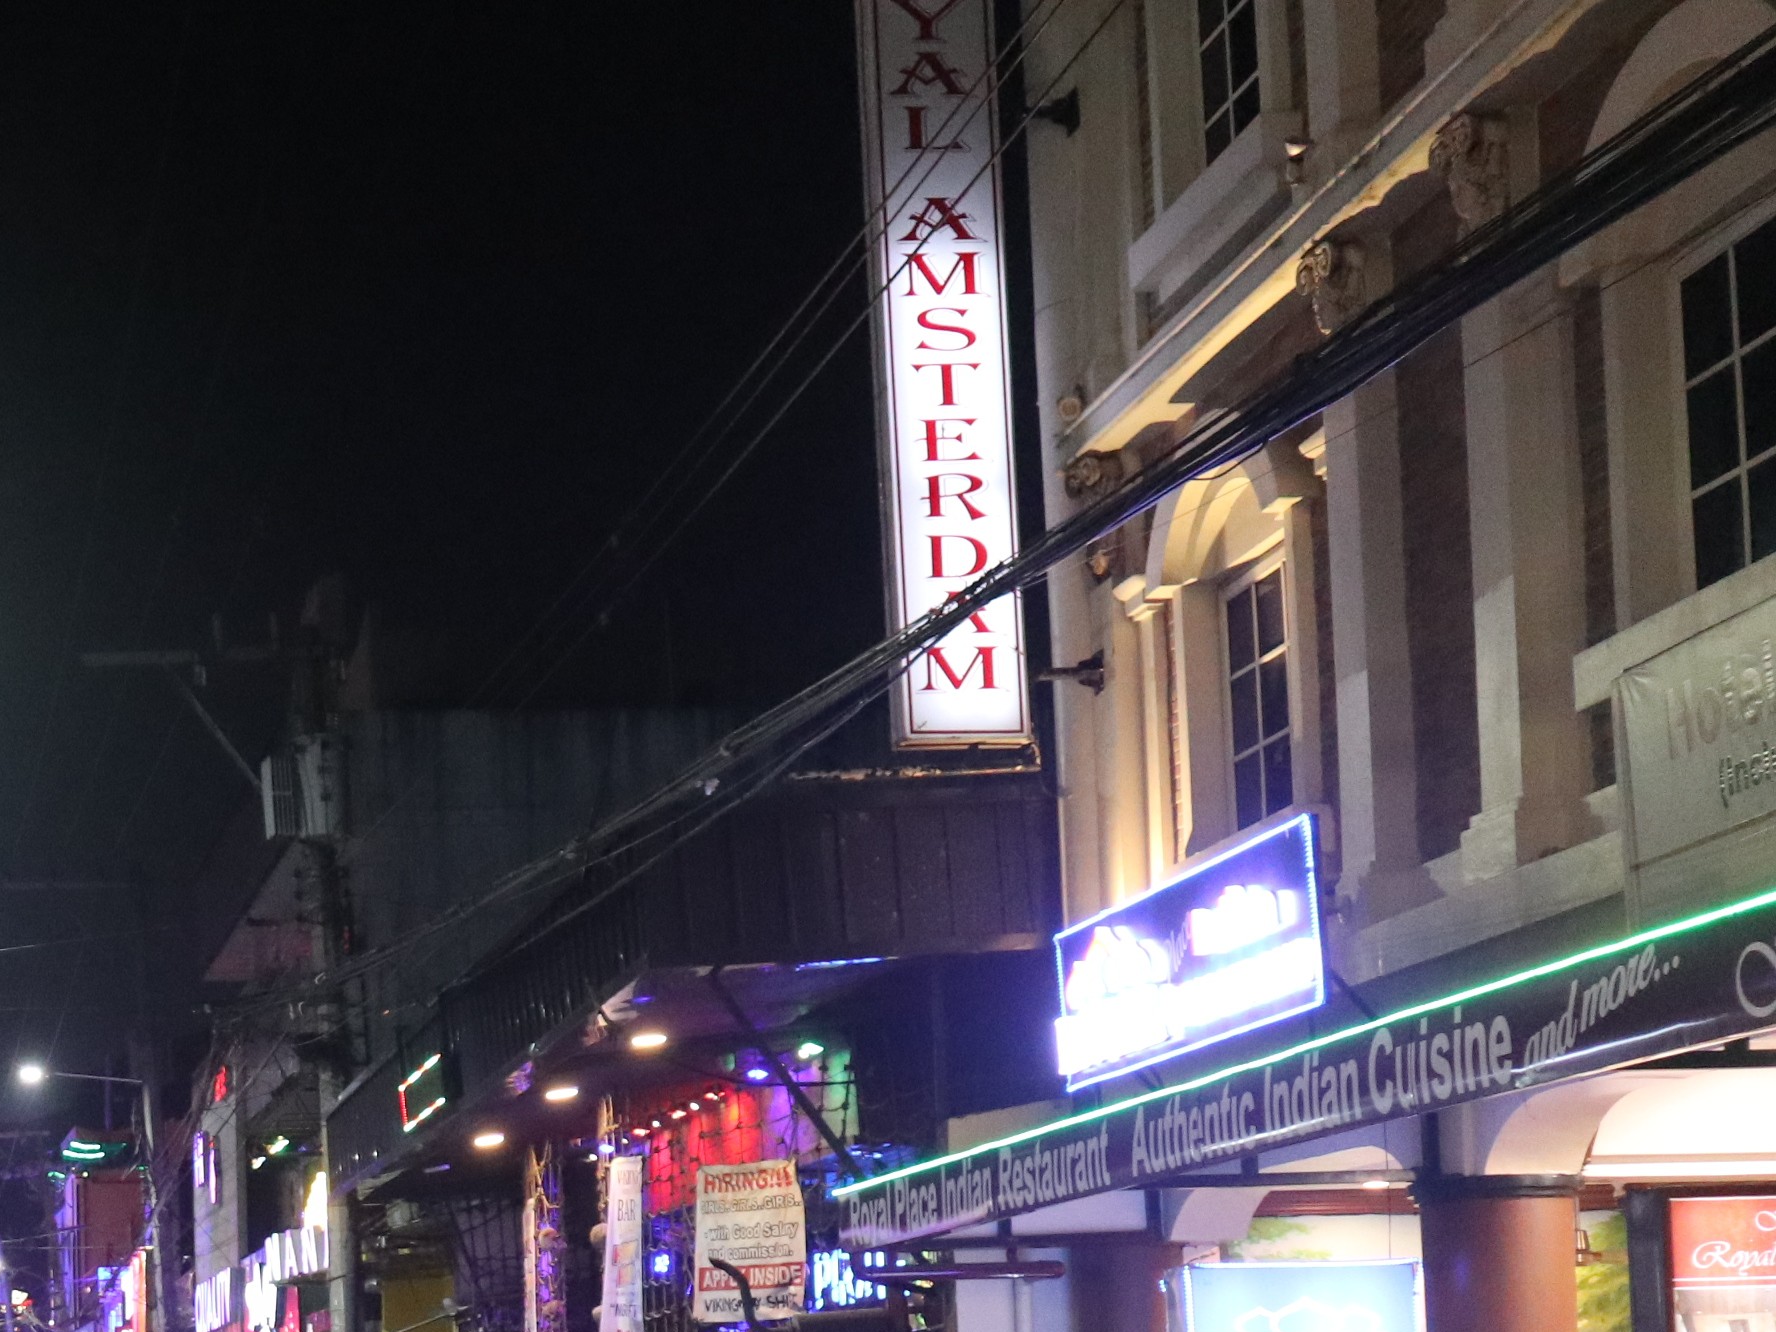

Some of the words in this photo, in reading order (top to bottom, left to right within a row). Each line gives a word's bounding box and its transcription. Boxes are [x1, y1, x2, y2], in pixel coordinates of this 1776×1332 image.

[849, 1180, 893, 1246] Royal
[894, 1176, 938, 1234] Place
[940, 1157, 994, 1224] Indian
[997, 1118, 1111, 1211] Restaurant
[1131, 1084, 1257, 1178] Authentic
[1263, 1048, 1363, 1139] Indian
[1368, 1004, 1513, 1114] Cuisine
[1525, 979, 1579, 1073] and
[617, 1199, 636, 1222] BAR
[732, 1223, 760, 1240] Good
[749, 1264, 802, 1287] INSIDE
